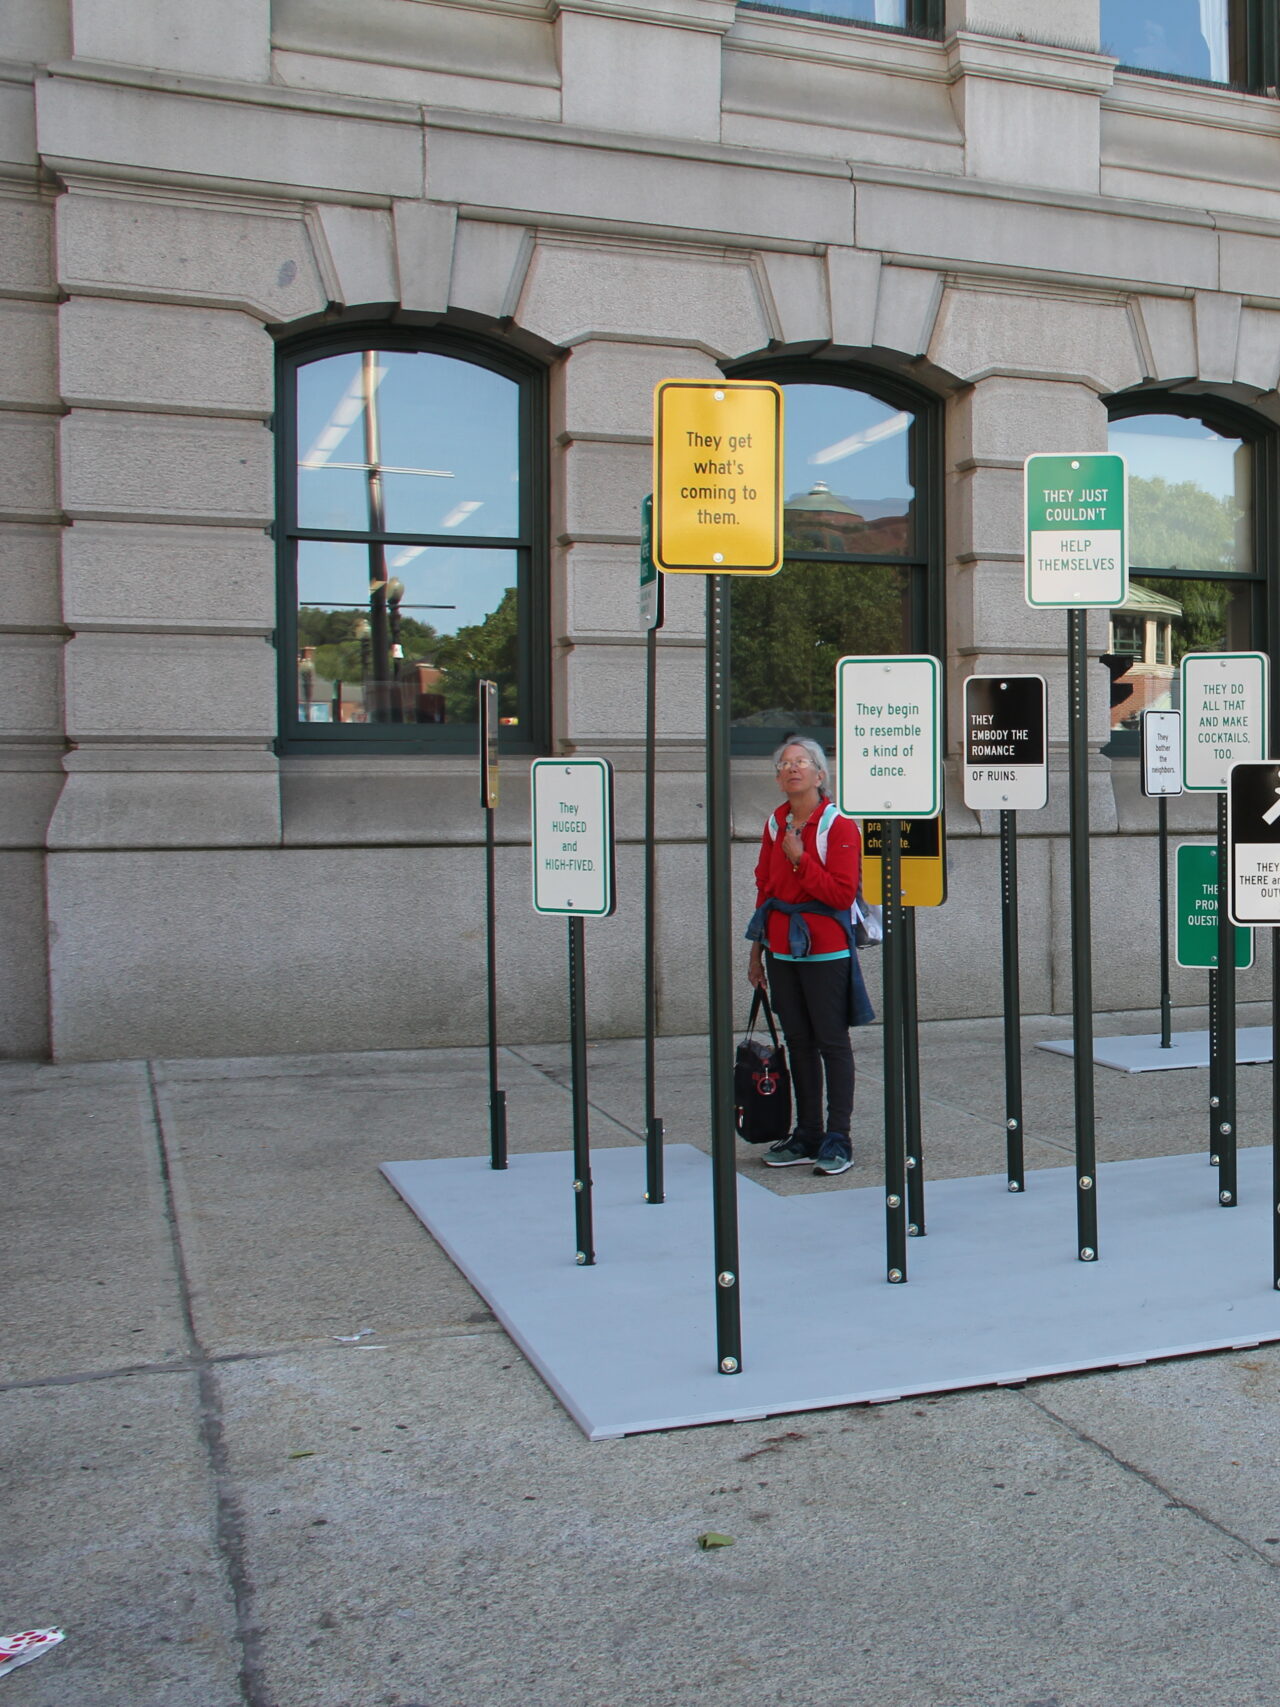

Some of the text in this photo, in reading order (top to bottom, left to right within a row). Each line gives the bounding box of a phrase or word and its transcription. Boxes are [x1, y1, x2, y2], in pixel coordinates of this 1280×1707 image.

[686, 432, 753, 453] They get
[694, 459, 744, 475] what's
[681, 485, 757, 504] coming to
[1043, 489, 1109, 503] THEY JUST
[697, 509, 740, 525] them.
[1046, 508, 1107, 521] COULDN'T
[1060, 539, 1092, 553] HELP
[1038, 558, 1115, 571] THEMSELVES
[1203, 683, 1244, 695] THEY DO
[856, 702, 920, 719] They begin
[1202, 700, 1246, 711] ALL THAT
[971, 714, 994, 725] THEY
[1199, 716, 1249, 727] AND MAKE
[855, 724, 921, 737] to resemble
[971, 729, 1029, 741] EMBODY THE
[1157, 732, 1169, 743] They
[862, 744, 914, 757] a kind of
[971, 745, 1016, 756] ROMANCE
[1155, 744, 1171, 752] bother
[1213, 748, 1234, 760] TOO.
[1159, 755, 1168, 763] the
[869, 765, 907, 777] dance.
[972, 770, 1018, 782] OF RUINS.
[559, 802, 579, 817] They
[552, 820, 587, 833] HUGGED
[562, 841, 578, 852] and
[545, 859, 596, 872] HIGH-FIVED.
[1256, 862, 1280, 873] THEY
[1239, 875, 1269, 886] THERE
[1202, 884, 1219, 895] THE
